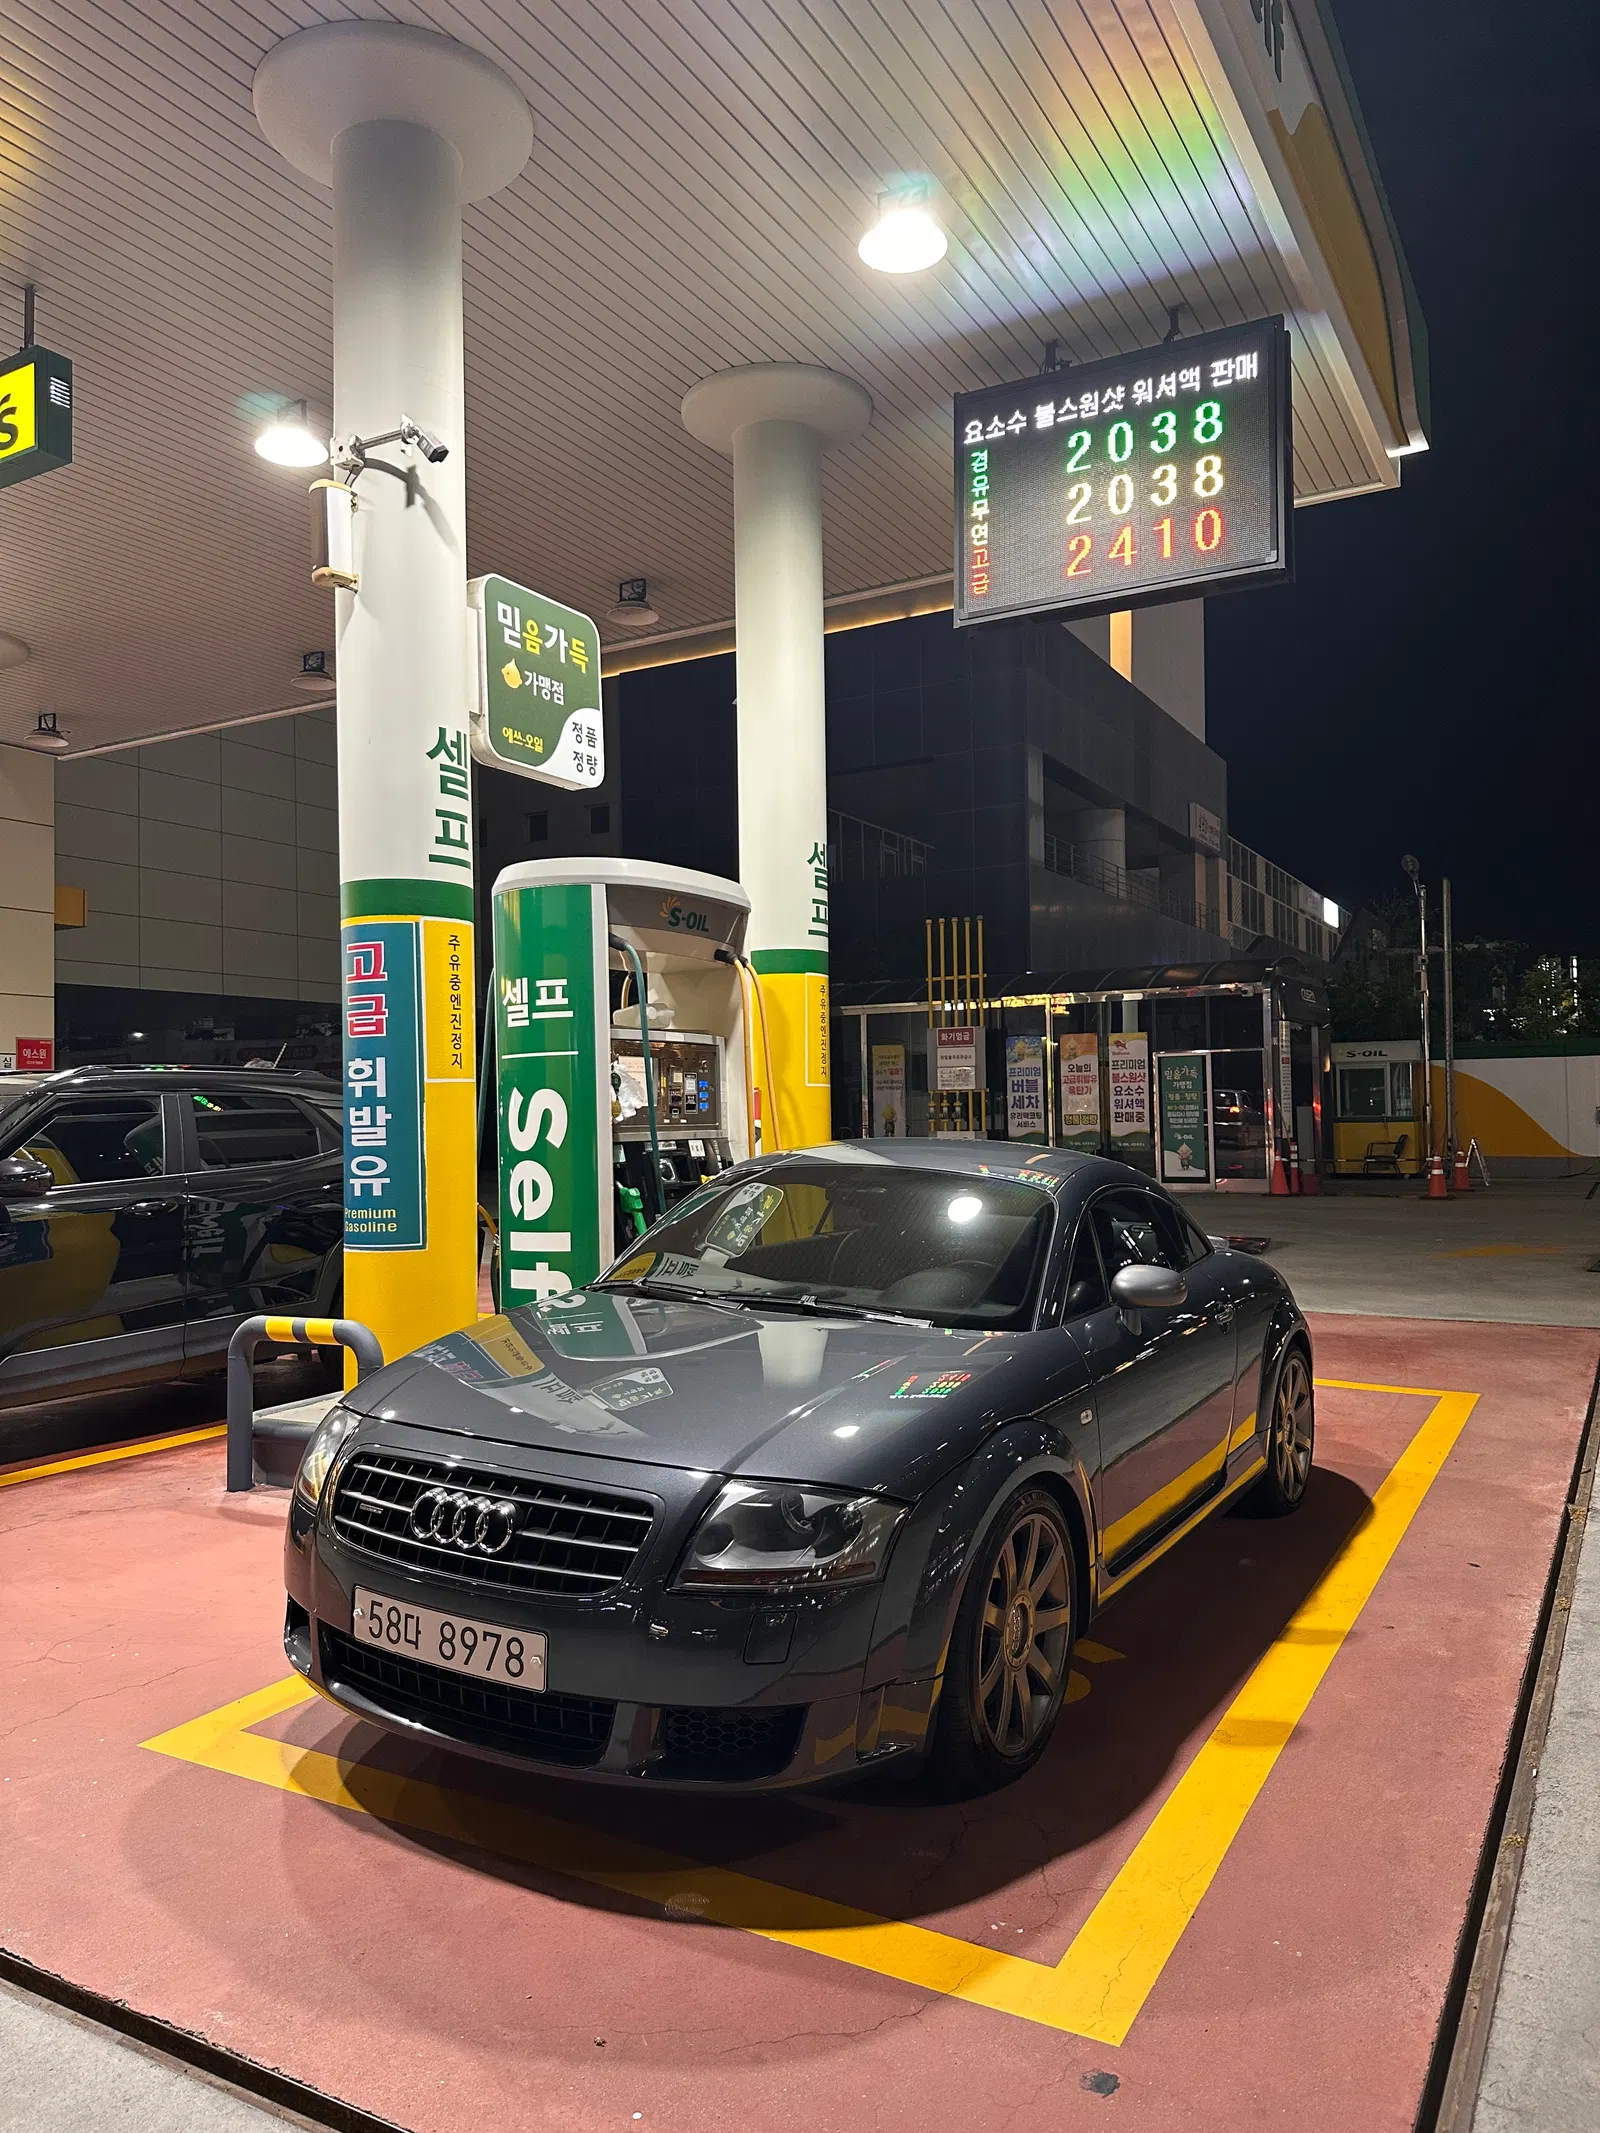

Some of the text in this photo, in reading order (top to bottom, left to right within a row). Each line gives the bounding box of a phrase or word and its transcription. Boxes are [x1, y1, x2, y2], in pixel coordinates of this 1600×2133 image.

[963, 351, 1258, 445] 요소수 불스원샷 워셔액 판매
[1066, 400, 1223, 473] 2038
[1066, 454, 1224, 526] 2038
[971, 498, 990, 546] 무연
[1066, 508, 1222, 578] 2410
[971, 548, 990, 595] 고급
[497, 601, 589, 674] 믿음가득
[524, 669, 564, 706] 가맹점
[572, 721, 598, 749] 정품
[572, 750, 598, 777] 정량
[426, 726, 471, 870] 셀프
[668, 906, 709, 933] S-OIL
[502, 977, 575, 1029] 셀프
[941, 1031, 970, 1042] 화기엄금
[22, 1048, 47, 1059] 에스원
[1346, 1050, 1388, 1058] S-OIL
[346, 941, 393, 1197] 고급 휘발유
[1008, 1066, 1041, 1077] 프리미엄
[1067, 1063, 1091, 1073] 오늘의
[1111, 1059, 1146, 1071] 프리미엄
[1112, 1072, 1146, 1083] 불스원샷
[1164, 1065, 1198, 1080] 믿음가득
[1011, 1079, 1039, 1093] 버블
[1062, 1075, 1097, 1085] 고급휘발유
[1173, 1081, 1193, 1090] 가맹점
[1068, 1086, 1092, 1095] 옥탄가
[1113, 1085, 1145, 1097] 요소수
[1011, 1095, 1040, 1109] 세차
[1114, 1098, 1145, 1110] 워셔액
[1010, 1112, 1042, 1120] 유리막코팅
[1114, 1111, 1145, 1123] 판매중
[508, 1086, 573, 1304] Self
[345, 1208, 396, 1219] Premium
[345, 1221, 397, 1232] Gasoline
[369, 1600, 525, 1678] 58다 8978
